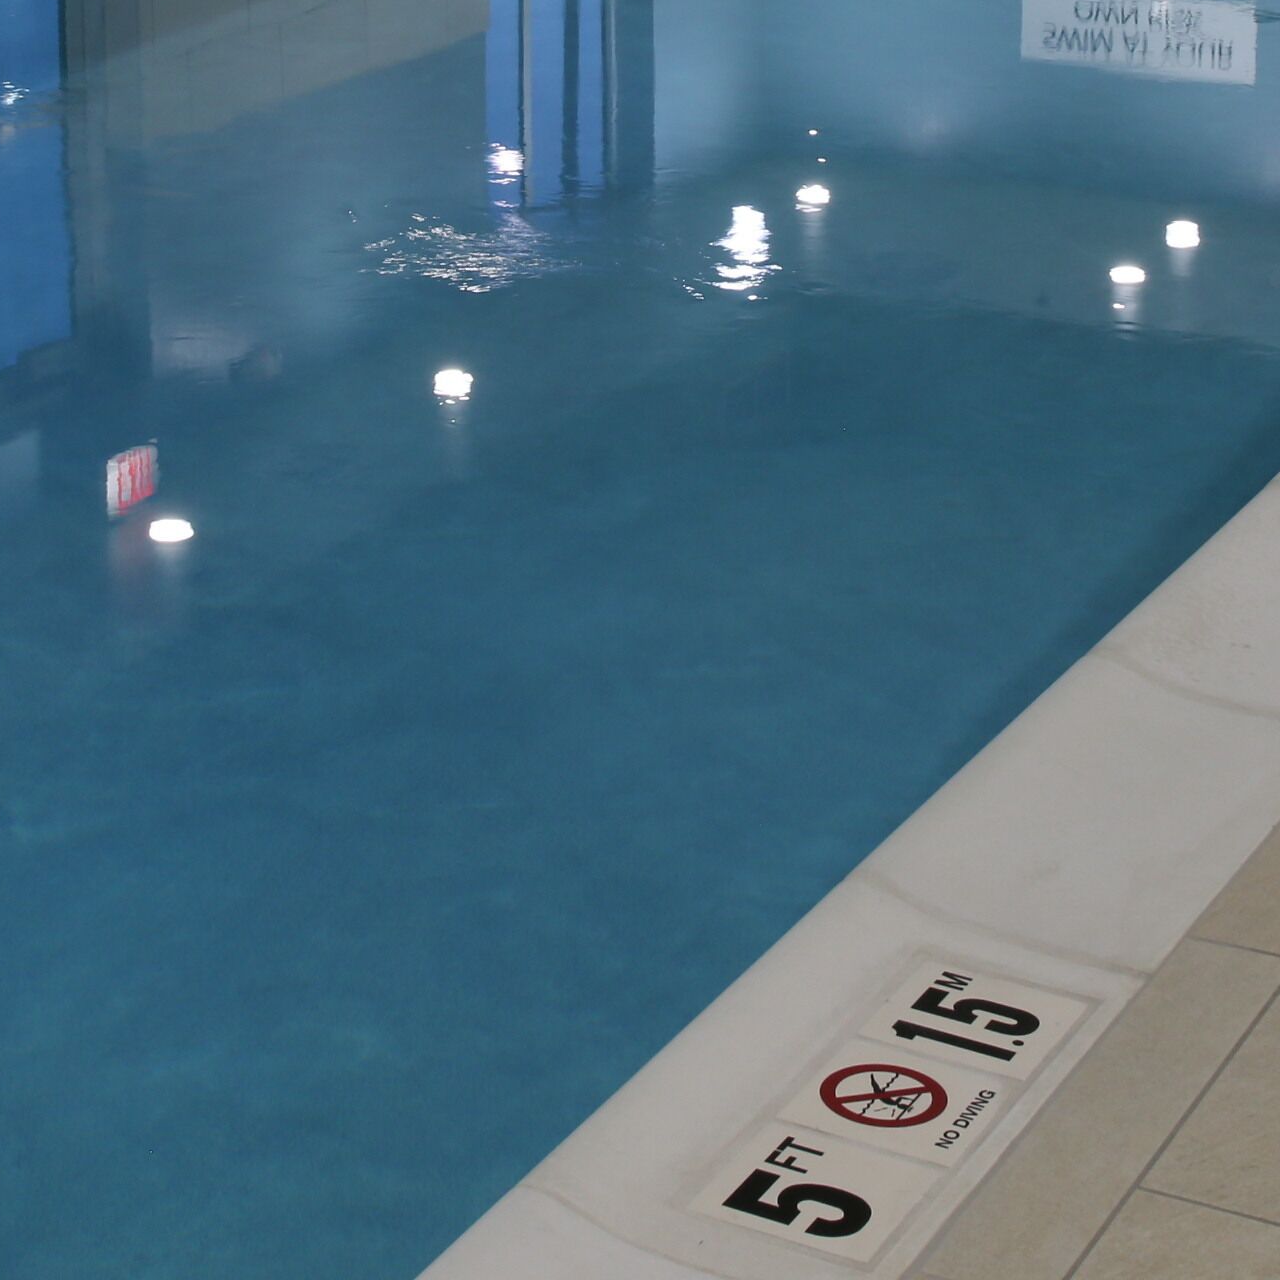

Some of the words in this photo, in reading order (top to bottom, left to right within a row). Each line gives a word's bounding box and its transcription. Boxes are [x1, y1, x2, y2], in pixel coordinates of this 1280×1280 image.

[933, 971, 974, 991] M
[892, 986, 1040, 1062] 1.5
[934, 1129, 961, 1150] NO
[953, 1089, 996, 1129] DIVING
[763, 1135, 825, 1174] FT
[721, 1168, 873, 1238] 5
